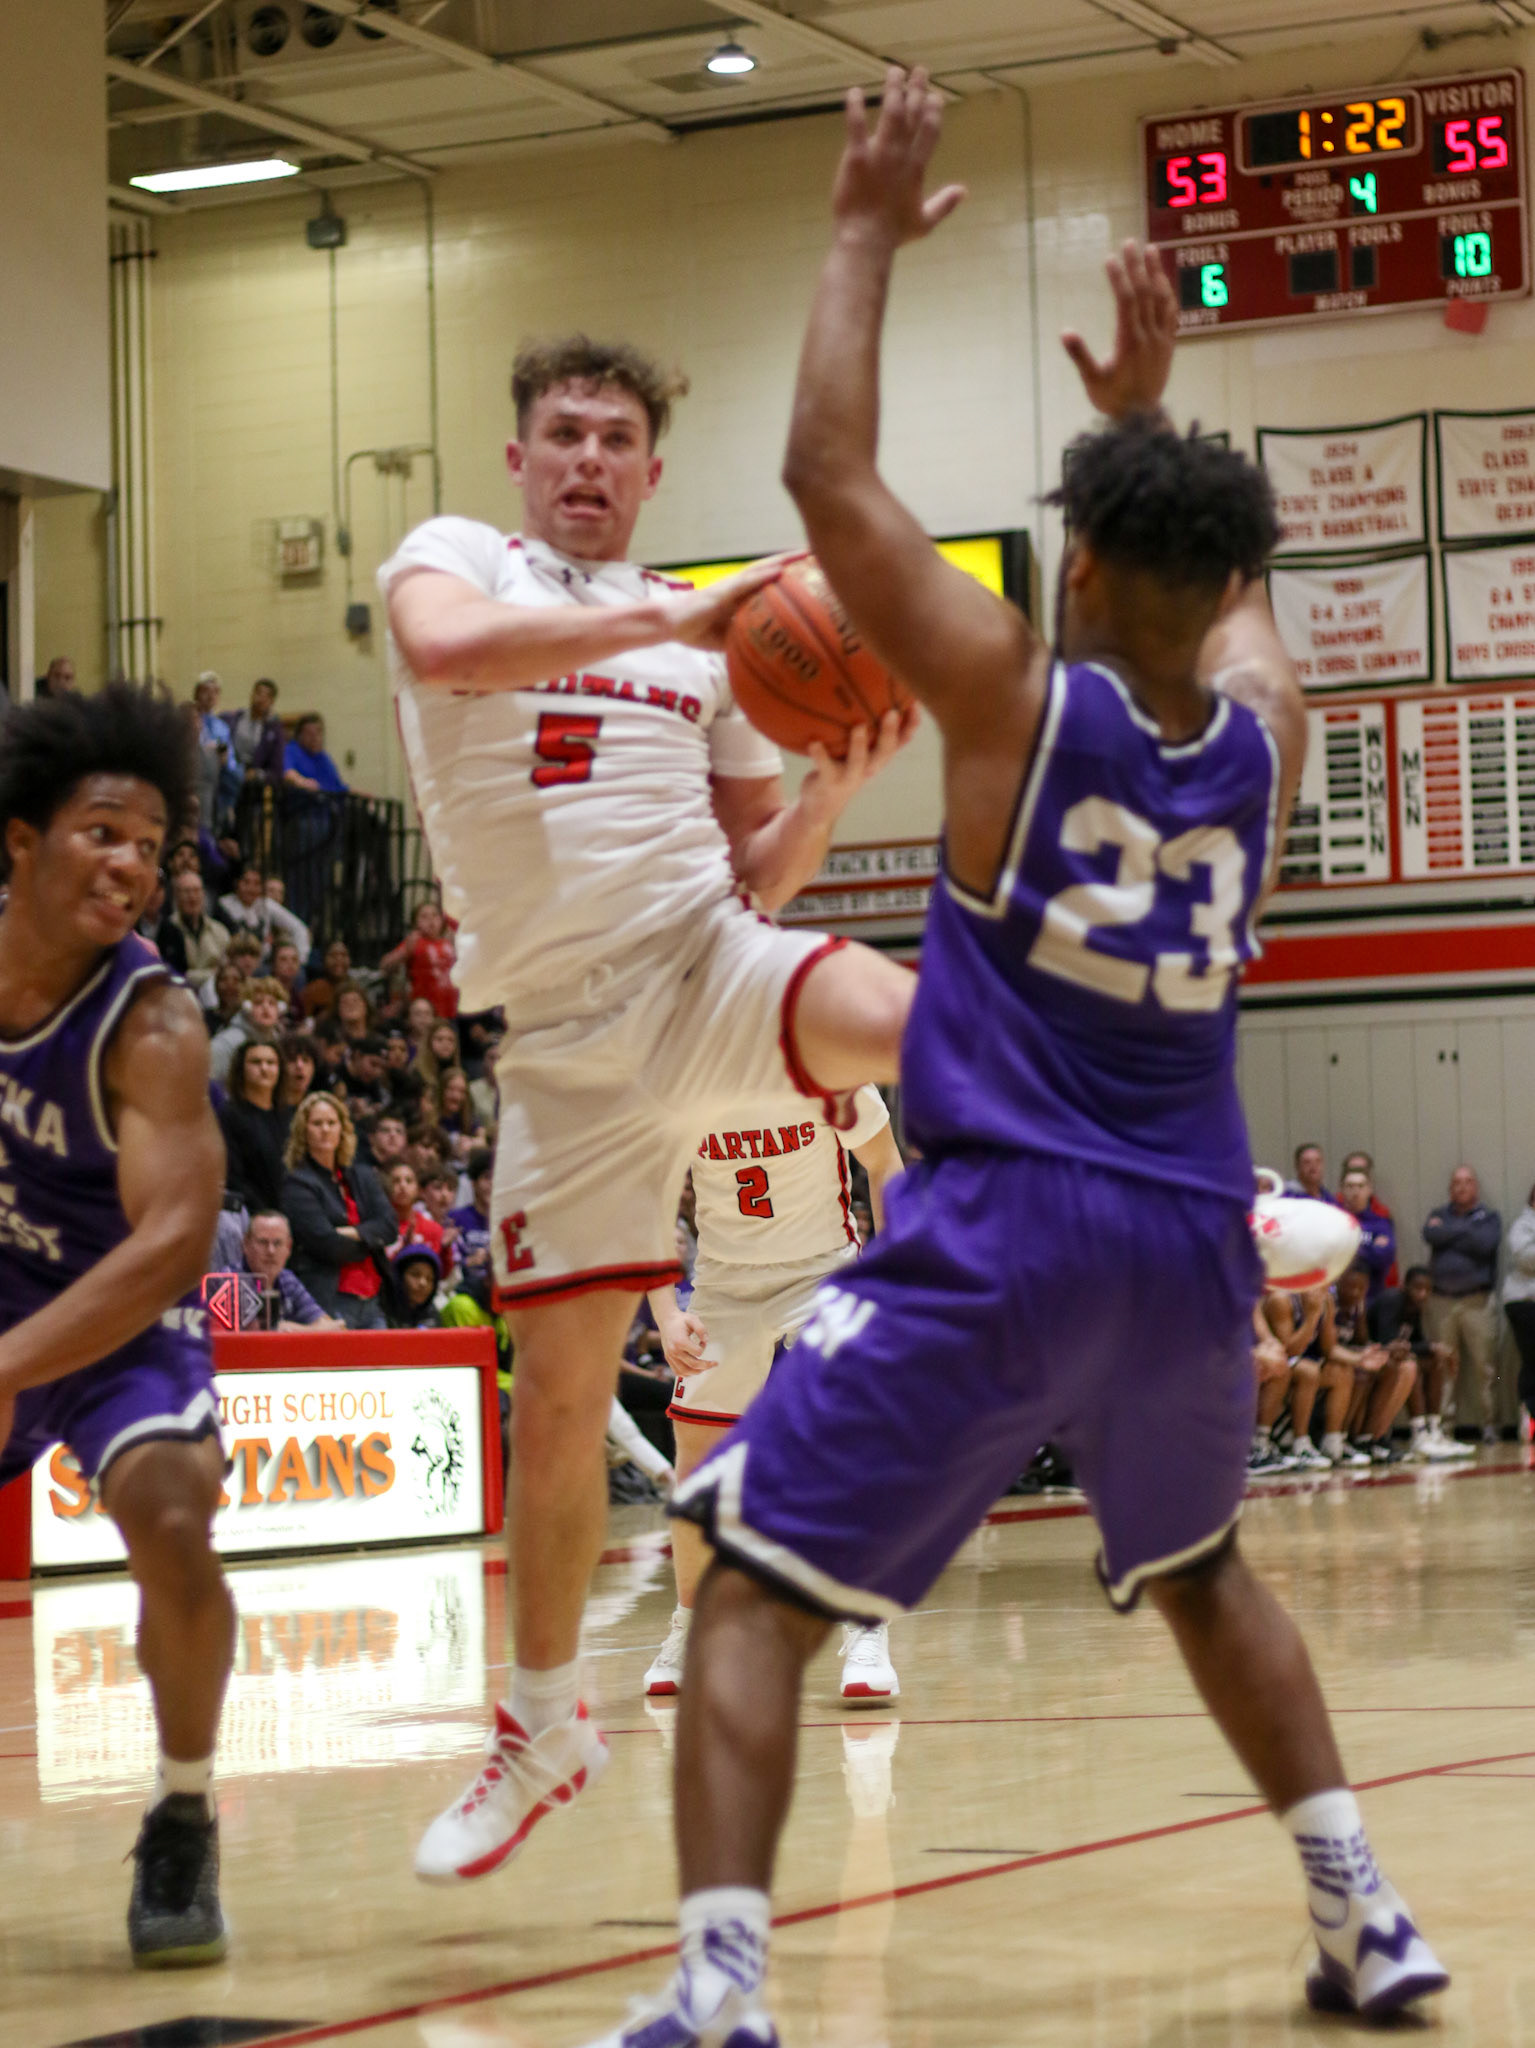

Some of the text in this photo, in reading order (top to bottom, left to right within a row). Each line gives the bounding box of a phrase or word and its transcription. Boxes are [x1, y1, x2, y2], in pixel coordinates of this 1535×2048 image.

[1422, 80, 1514, 115] VISITOR
[1156, 118, 1223, 149] HOME
[1298, 97, 1406, 159] 1:22
[1445, 116, 1508, 173] 55
[1166, 152, 1227, 208] 53
[1281, 184, 1344, 208] PERIOD
[1349, 171, 1378, 214] 4
[1422, 179, 1481, 204] BONUS
[1182, 208, 1239, 234] BONUS
[1275, 222, 1403, 255] PLAYER FOULS
[1437, 211, 1492, 236] FOULS
[1175, 243, 1229, 267] FOULS
[1454, 232, 1492, 278] 10
[1200, 263, 1228, 307] 6
[1310, 466, 1354, 487] CLASS
[1458, 478, 1496, 498] STATE
[1329, 485, 1406, 511] CHAMPIONS
[1321, 513, 1408, 537] BASKETBALL
[1311, 625, 1384, 648] CHAMPIONS
[530, 711, 604, 789] 5
[1364, 727, 1386, 854] WOMEN
[1402, 751, 1422, 826] MEN
[1026, 795, 1246, 1012] 23
[735, 1165, 774, 1218] 2
[500, 1210, 535, 1273] E
[220, 1391, 394, 1425] IGH SCHOOL
[48, 1431, 395, 1518] STANS
